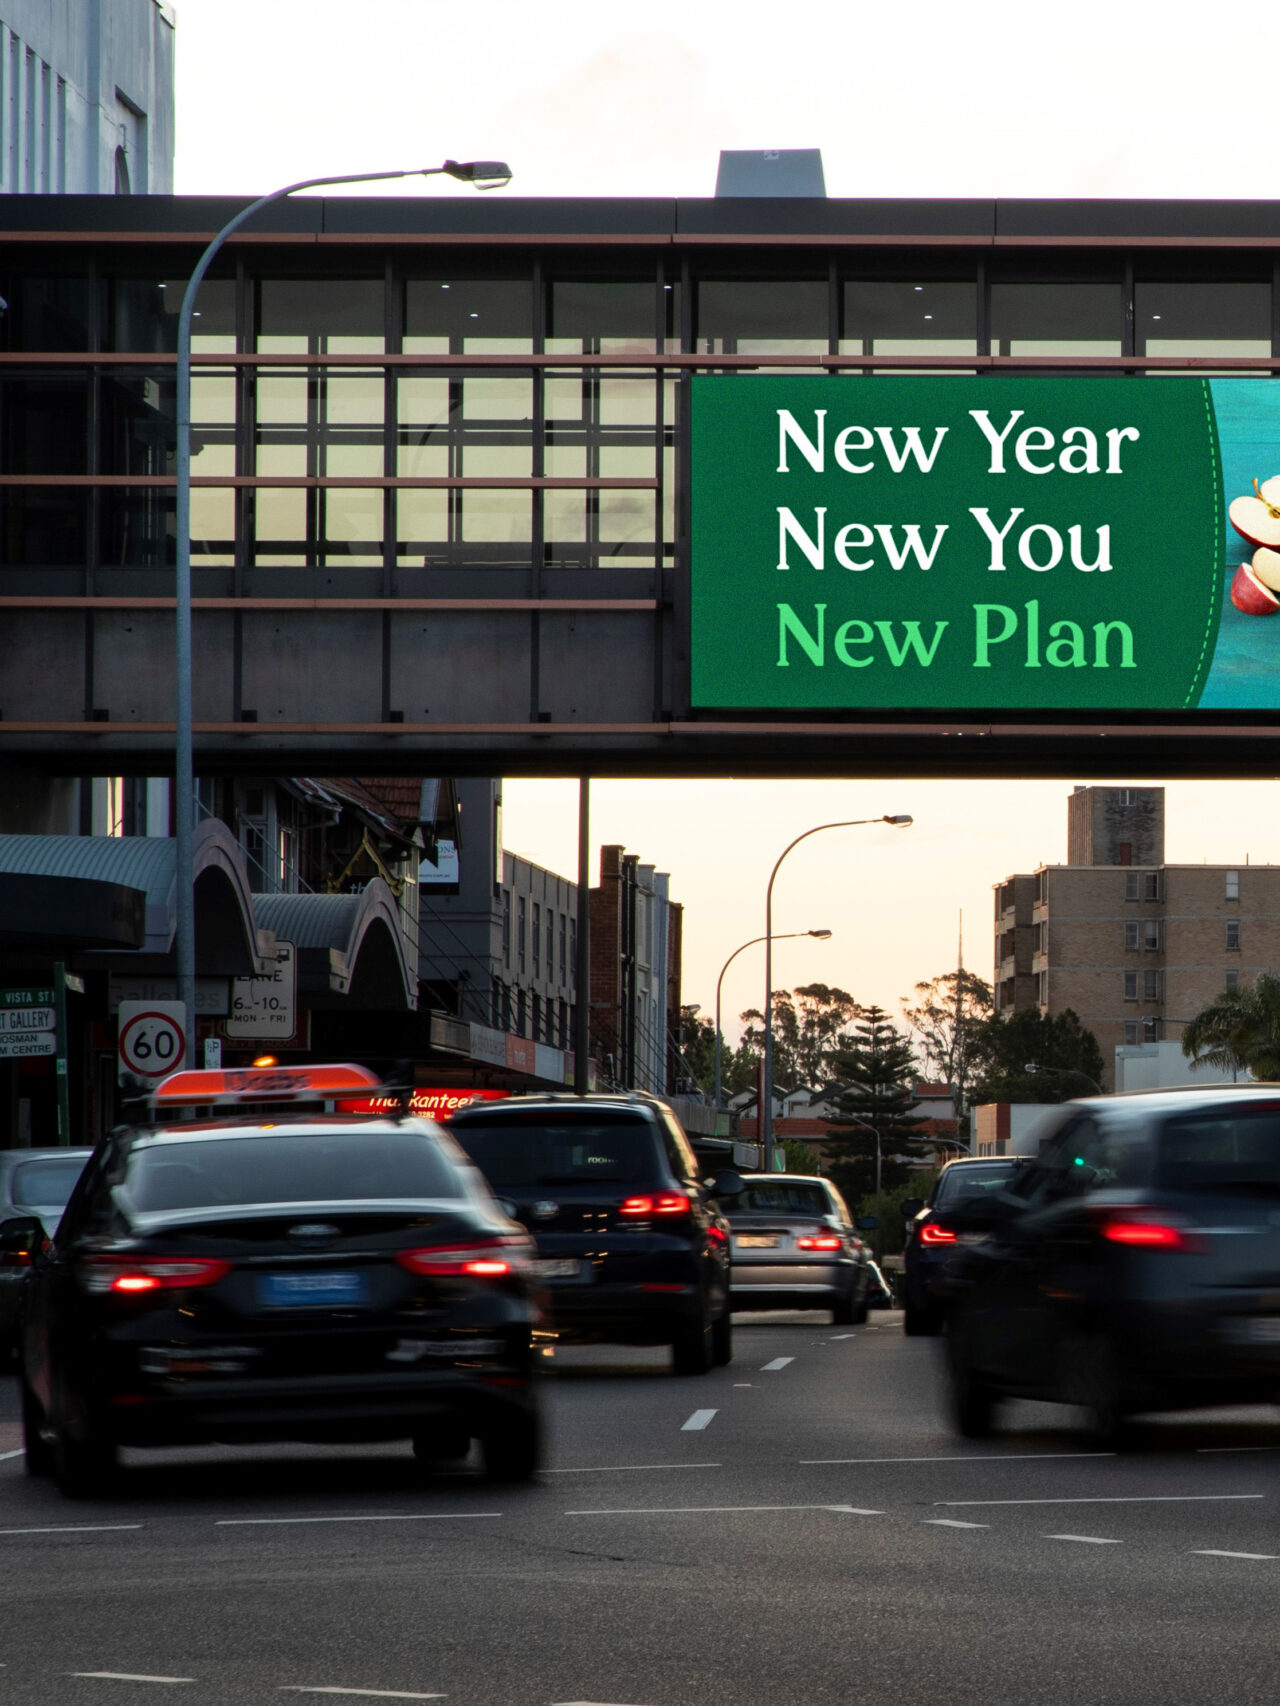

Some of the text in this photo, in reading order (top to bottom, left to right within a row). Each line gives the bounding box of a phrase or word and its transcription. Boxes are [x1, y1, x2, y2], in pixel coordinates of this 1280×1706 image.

[776, 409, 1140, 474] New Year
[776, 507, 1113, 572] New You
[776, 599, 1137, 668] New Plan
[5, 991, 33, 1003] VISTA
[38, 991, 49, 1003] ST
[10, 1011, 50, 1029] GALLERY
[234, 1014, 256, 1022] MON
[270, 1014, 286, 1022] FRI
[12, 1044, 52, 1054] CENTRE
[133, 1030, 174, 1058] 60
